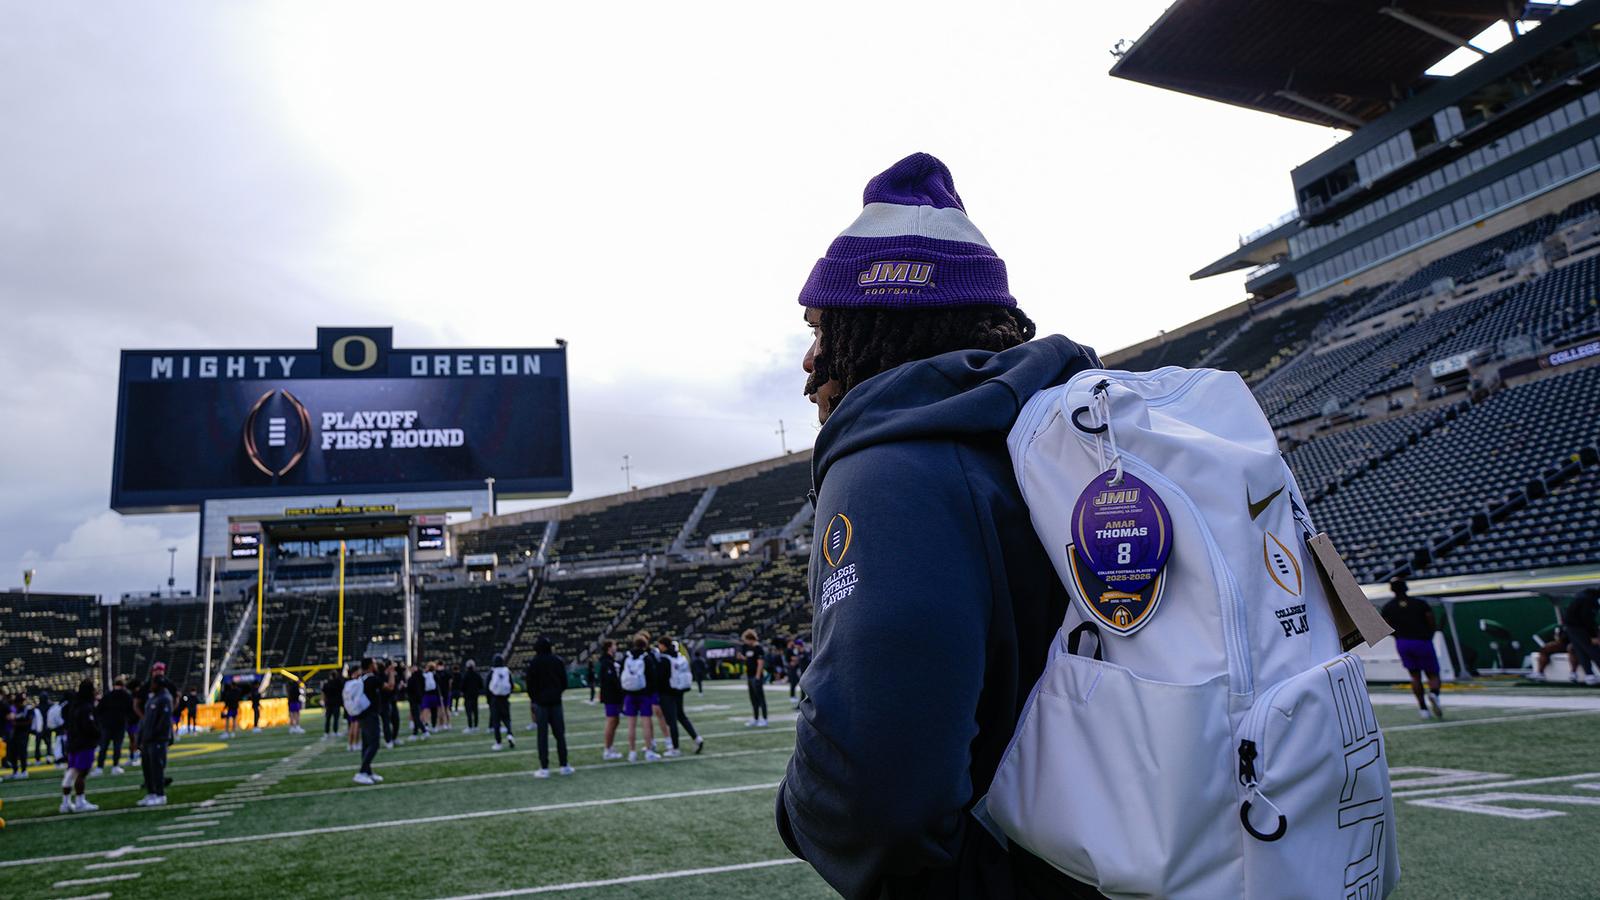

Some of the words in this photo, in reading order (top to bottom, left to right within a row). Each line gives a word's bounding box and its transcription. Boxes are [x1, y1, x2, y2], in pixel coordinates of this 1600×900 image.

[859, 262, 932, 284] JMU
[864, 287, 921, 296] FOOTBALL
[332, 335, 378, 371] O
[150, 356, 297, 379] MIGHTY
[410, 354, 542, 376] OREGON
[321, 410, 418, 430] PLAYOFF
[320, 430, 388, 450] FIRST
[390, 428, 465, 448] ROUND
[1094, 489, 1139, 506] JMU
[1095, 527, 1148, 539] THOMAS
[1105, 520, 1135, 529] AMAR
[1117, 543, 1131, 565] 8
[822, 563, 856, 592] COLLEGE
[1105, 573, 1151, 582] 2025-2026
[820, 585, 855, 614] PLAYOFF
[821, 573, 859, 605] FOOTBALL
